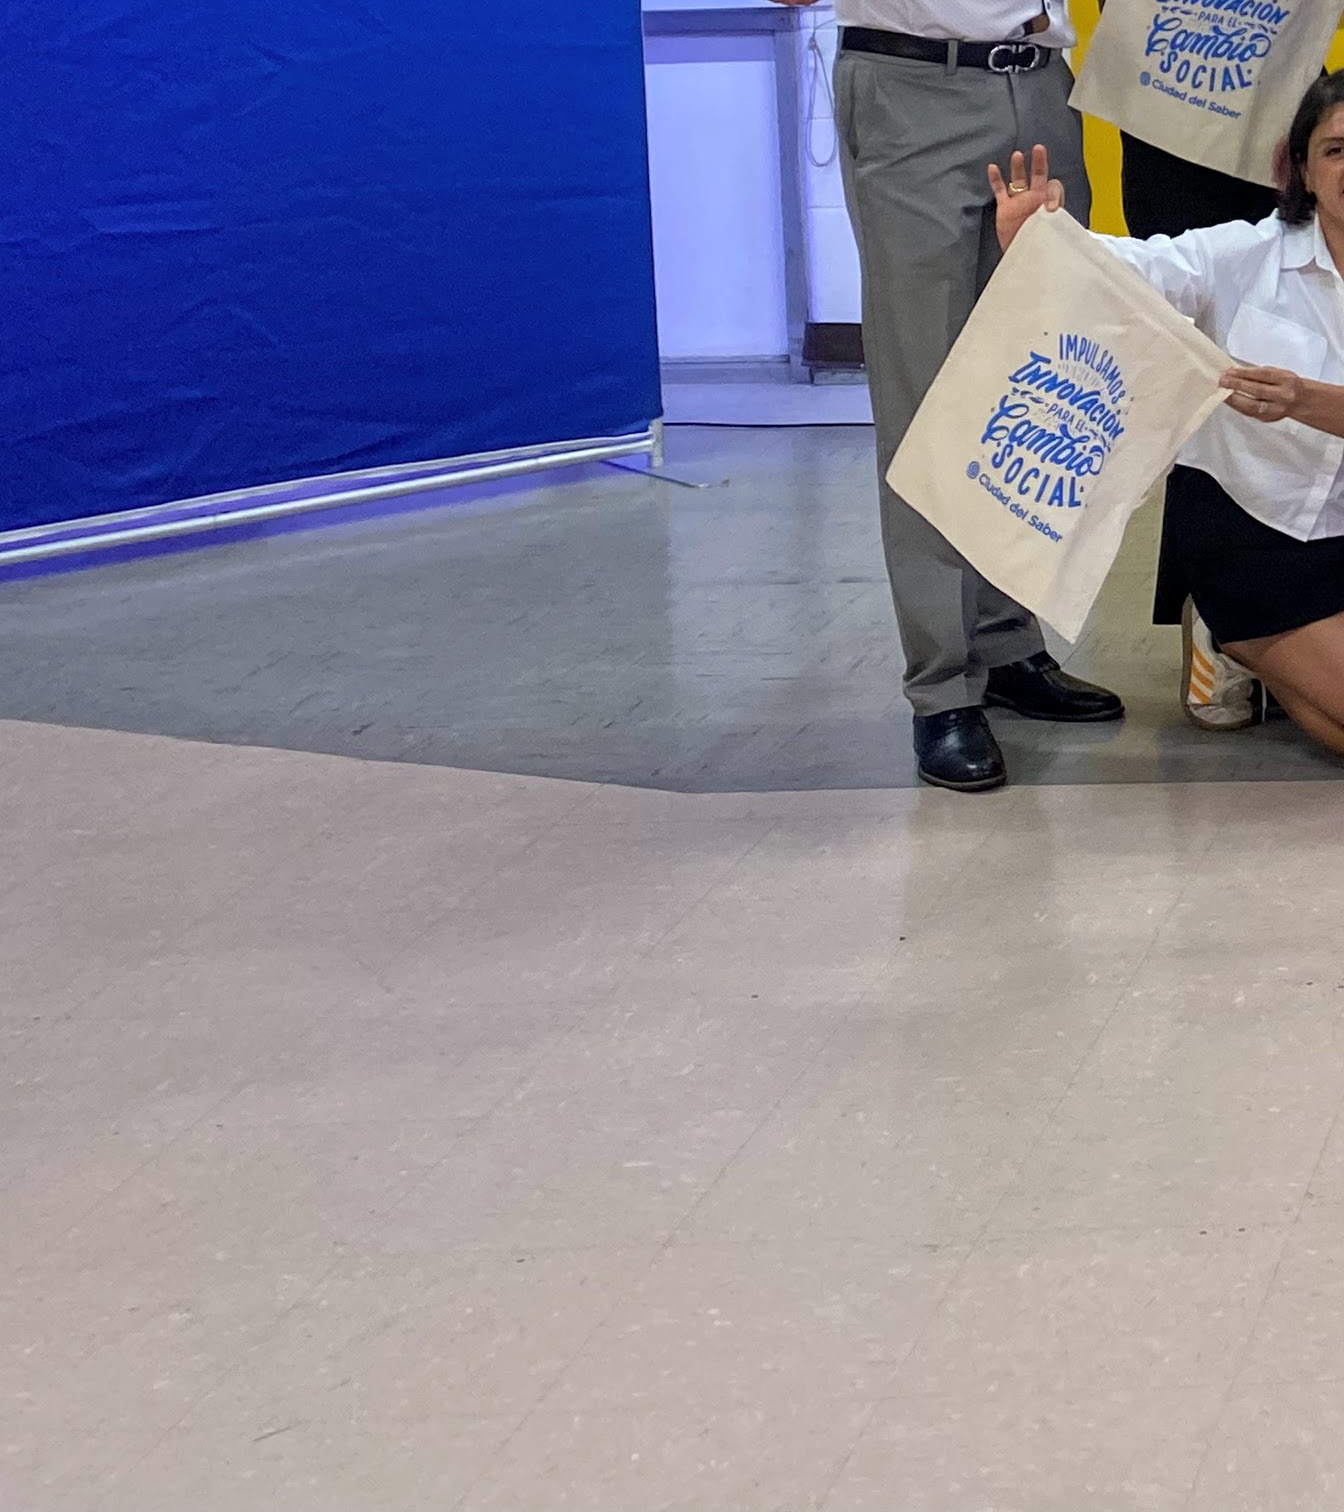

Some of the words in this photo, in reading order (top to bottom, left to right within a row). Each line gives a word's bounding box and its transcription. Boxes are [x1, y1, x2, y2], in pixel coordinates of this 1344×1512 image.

[1145, 14, 1272, 63] Cambio
[1160, 51, 1252, 92] SOCIAL
[1153, 79, 1186, 101] Ciudad
[1188, 92, 1206, 108] del
[1210, 101, 1241, 119] Saber
[1008, 352, 1124, 439] INNOVACIÓN
[1059, 333, 1126, 404] IMPULSAMOS
[981, 394, 1106, 477] Cambio
[979, 473, 1009, 505] Ciudad
[1008, 503, 1028, 521] del
[1029, 515, 1063, 543] Saber
[991, 443, 1082, 508] SOCIAL
